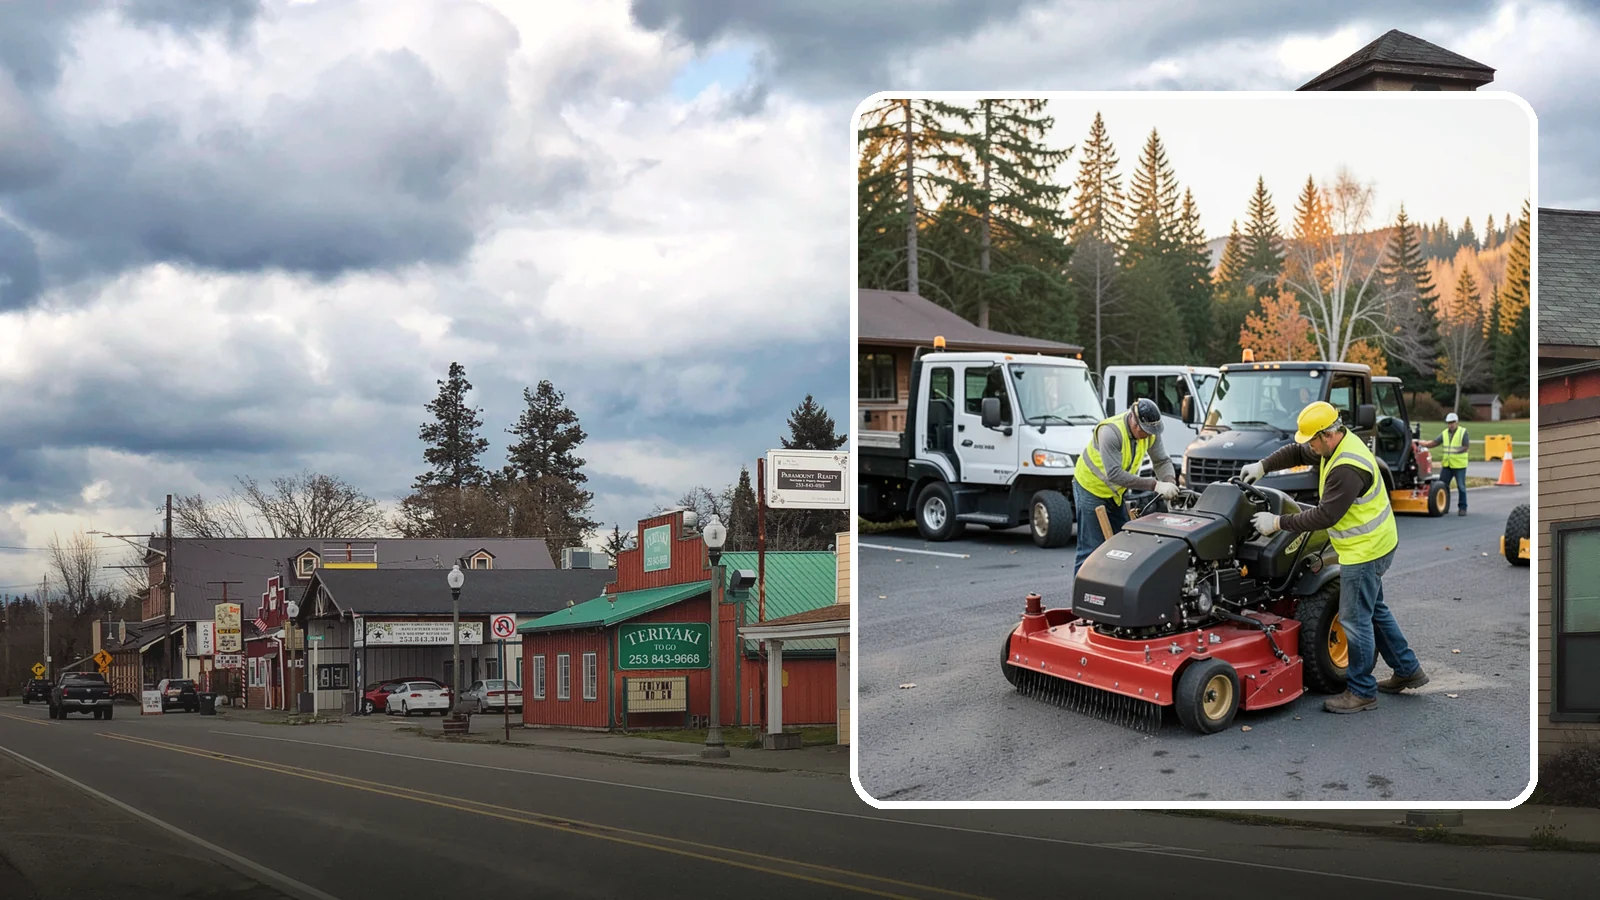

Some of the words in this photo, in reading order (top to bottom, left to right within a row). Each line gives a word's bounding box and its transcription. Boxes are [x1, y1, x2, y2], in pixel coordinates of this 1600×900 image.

[625, 628, 702, 646] TERIYAKI
[629, 654, 648, 664] 253
[652, 654, 700, 664] 843-9668
[639, 681, 672, 691] TERIYAKI
